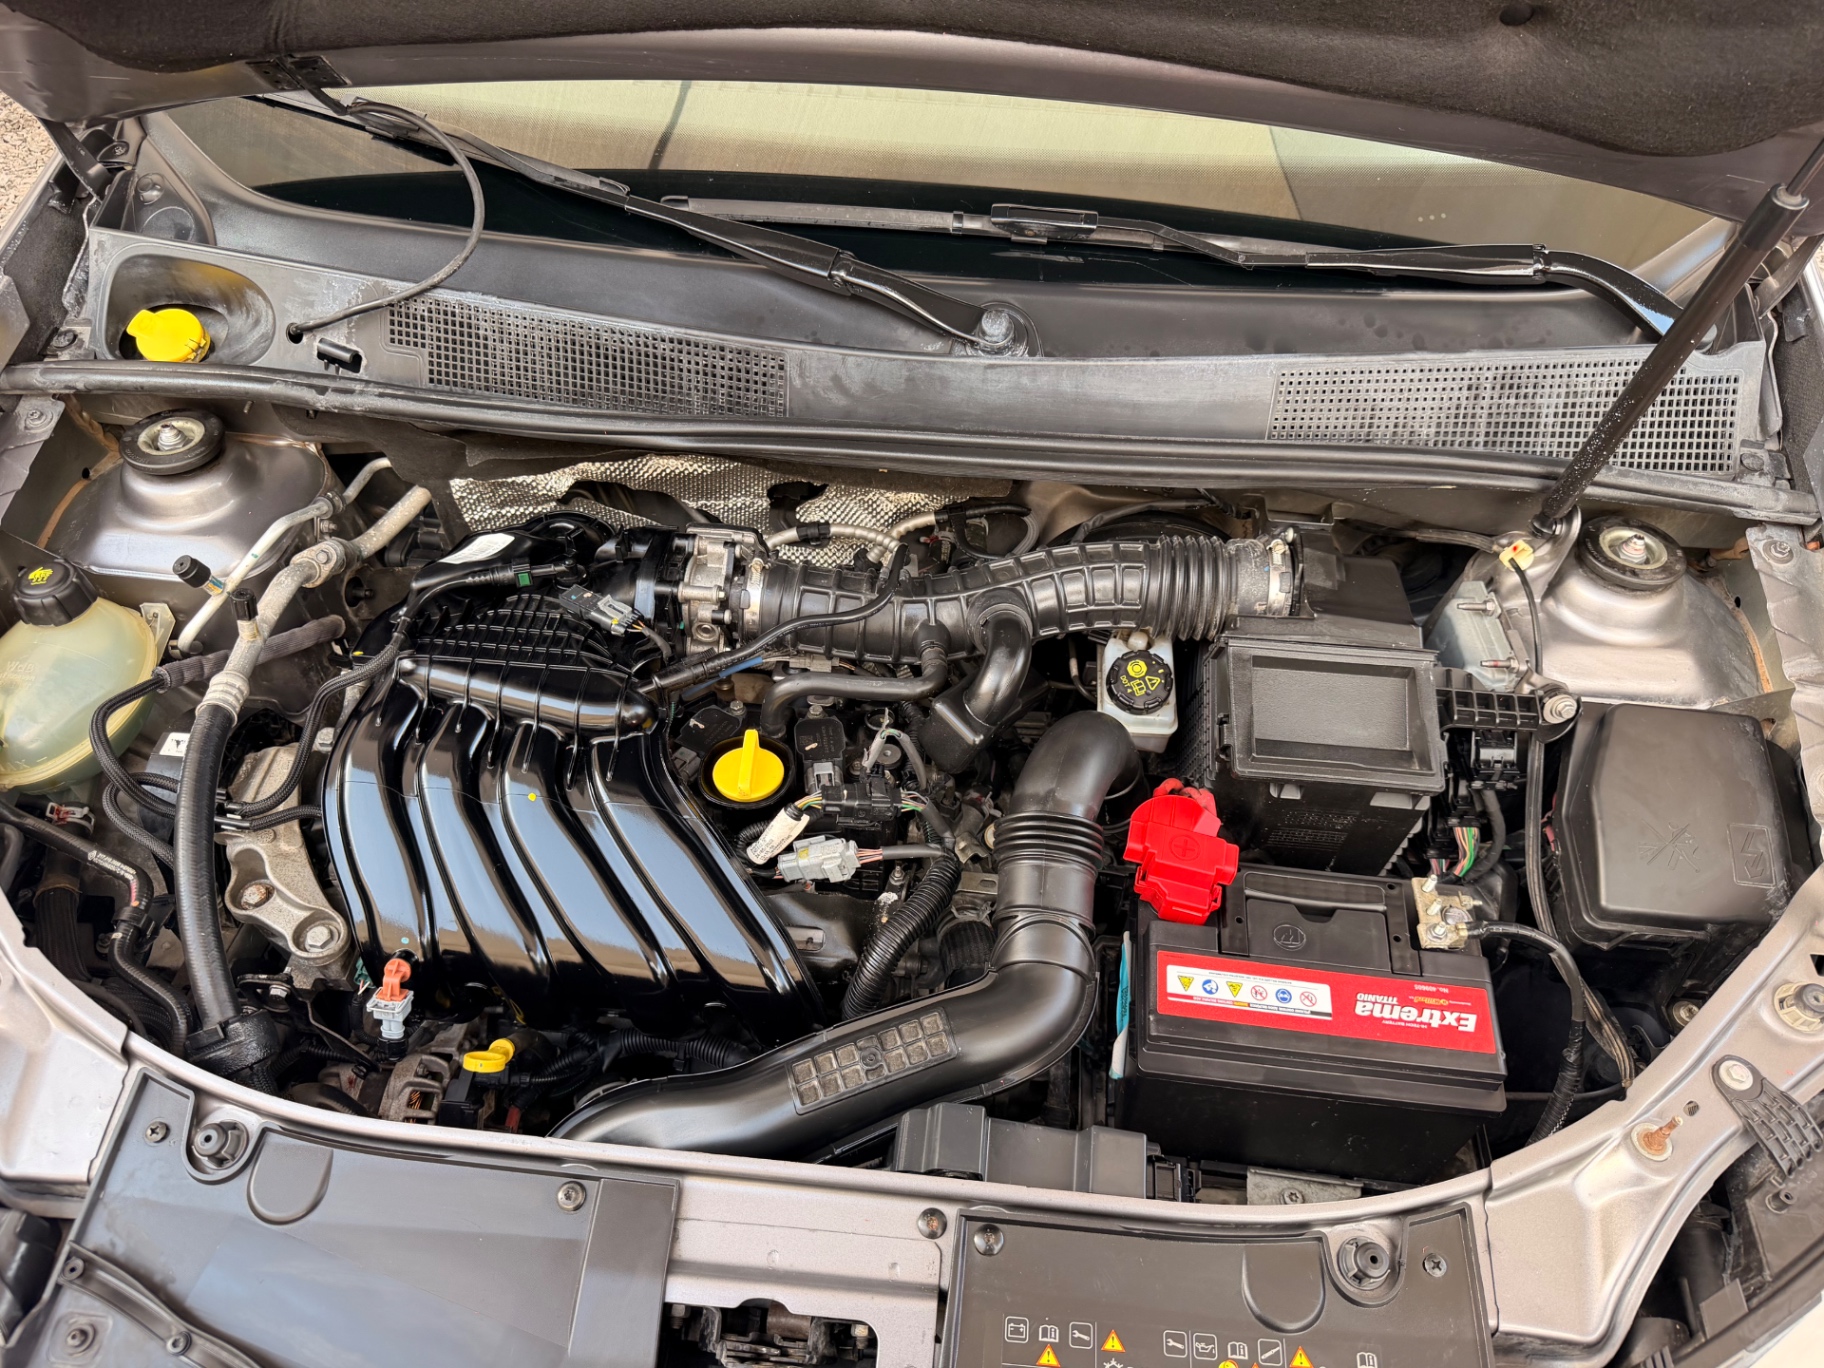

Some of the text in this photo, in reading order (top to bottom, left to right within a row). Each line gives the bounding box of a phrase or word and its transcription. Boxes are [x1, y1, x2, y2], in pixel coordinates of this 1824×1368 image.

[1120, 675, 1130, 687] DOT
[1357, 993, 1398, 1005] TITANIO
[1355, 1001, 1477, 1032] Extrema
[1382, 1019, 1405, 1027] BATTERY
